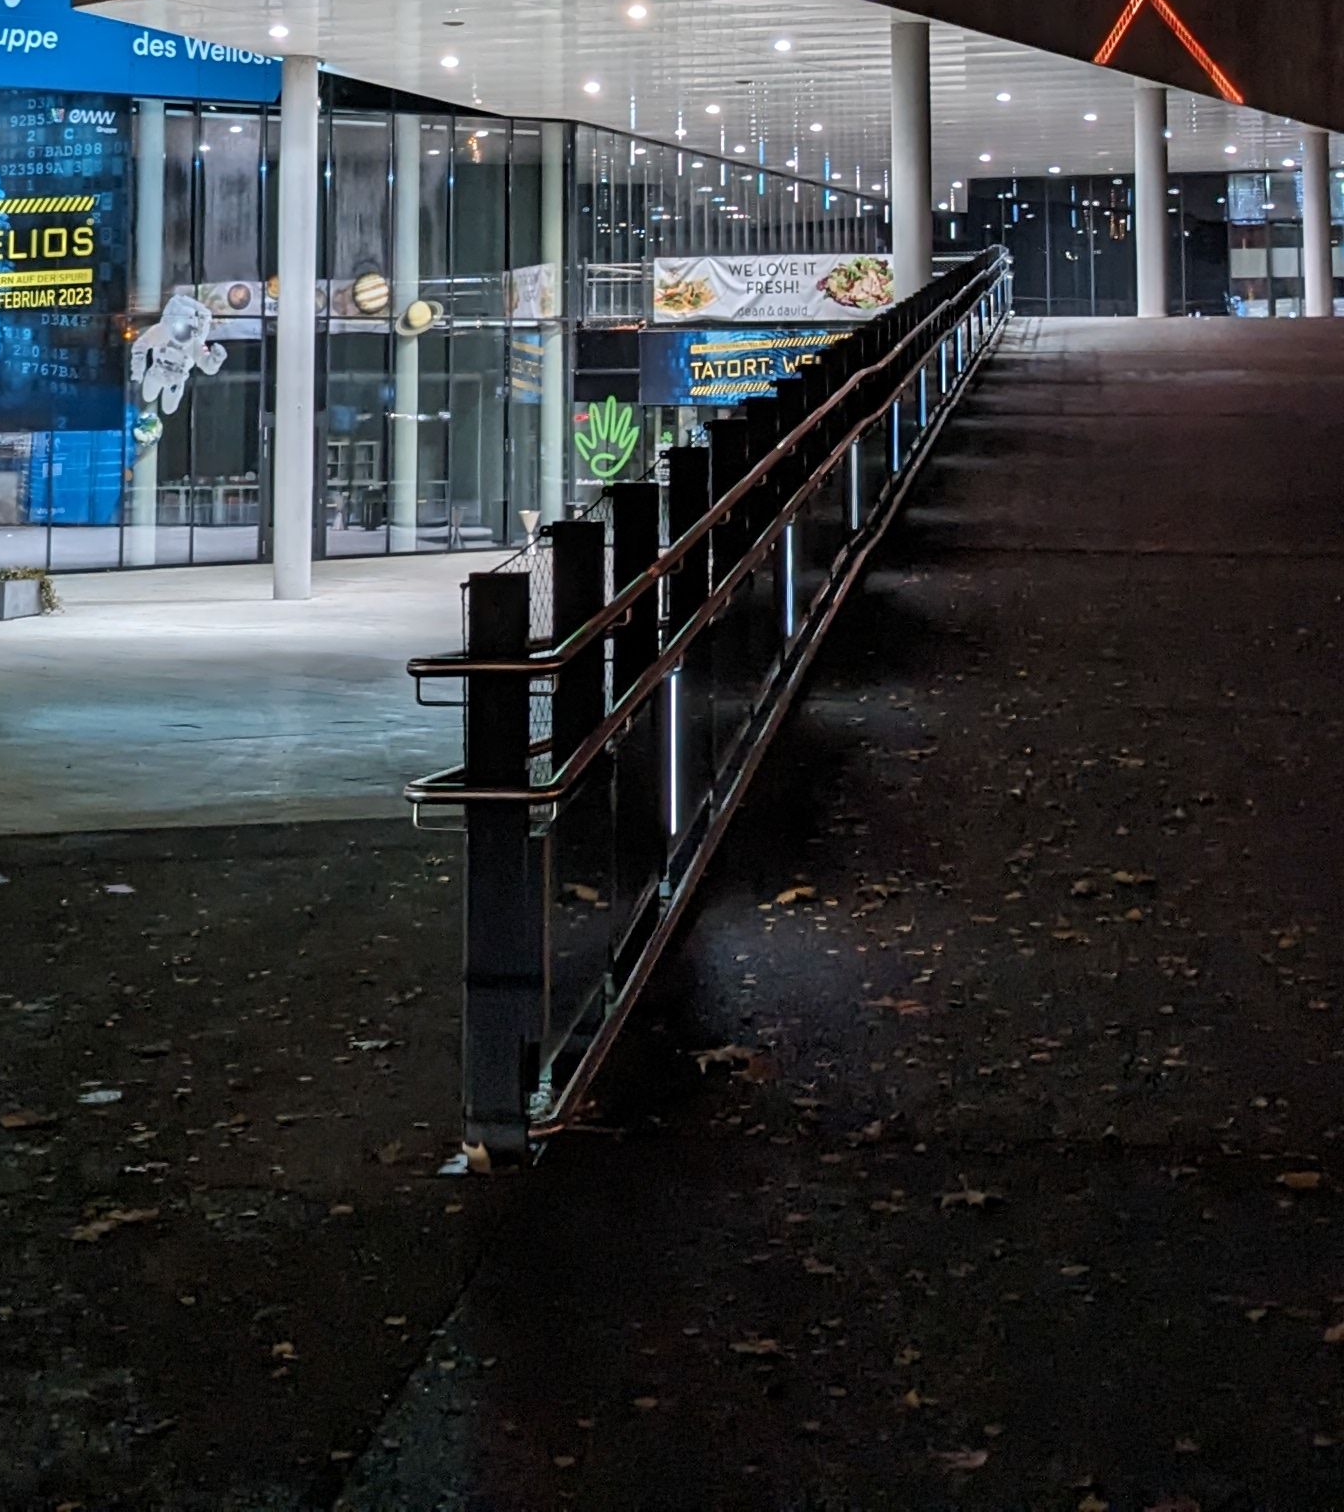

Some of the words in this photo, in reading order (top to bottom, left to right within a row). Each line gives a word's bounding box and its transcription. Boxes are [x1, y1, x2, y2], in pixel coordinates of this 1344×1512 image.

[133, 31, 177, 58] des
[17, 273, 34, 285] AUF
[37, 271, 56, 283] DER
[729, 263, 753, 277] WE
[759, 262, 798, 277] LOVE
[803, 262, 817, 276] IT
[747, 280, 800, 294] FRESH!
[59, 287, 93, 306] 2023
[691, 356, 775, 380] TATORT:
